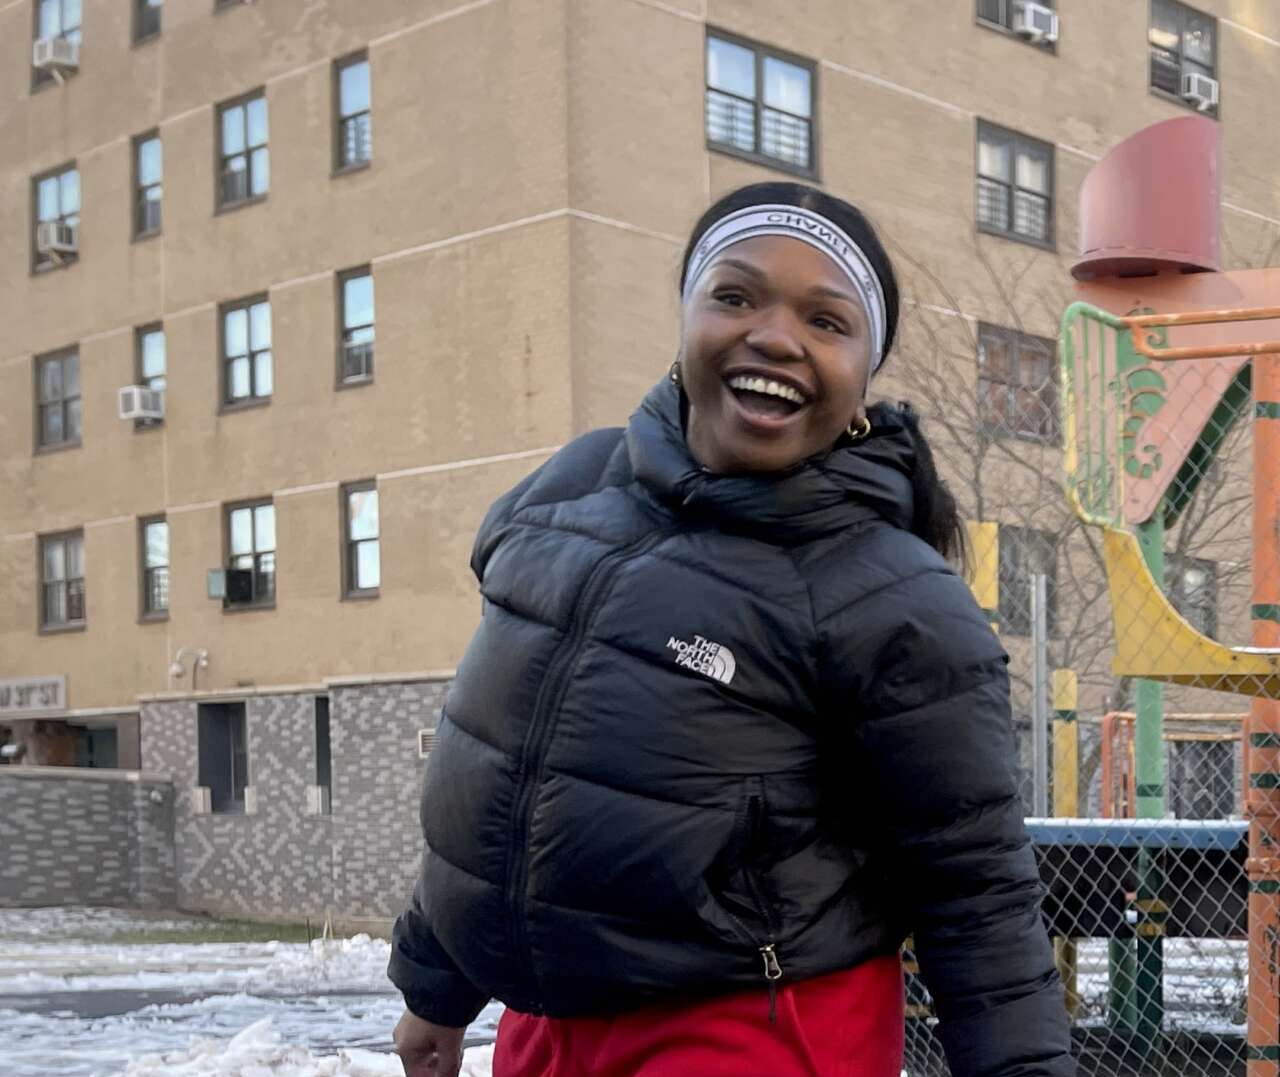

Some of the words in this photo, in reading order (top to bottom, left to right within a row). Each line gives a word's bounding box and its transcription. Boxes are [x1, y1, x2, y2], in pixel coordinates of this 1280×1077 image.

[666, 636, 716, 665] NORTH
[694, 635, 719, 653] THE
[675, 652, 710, 674] FACE
